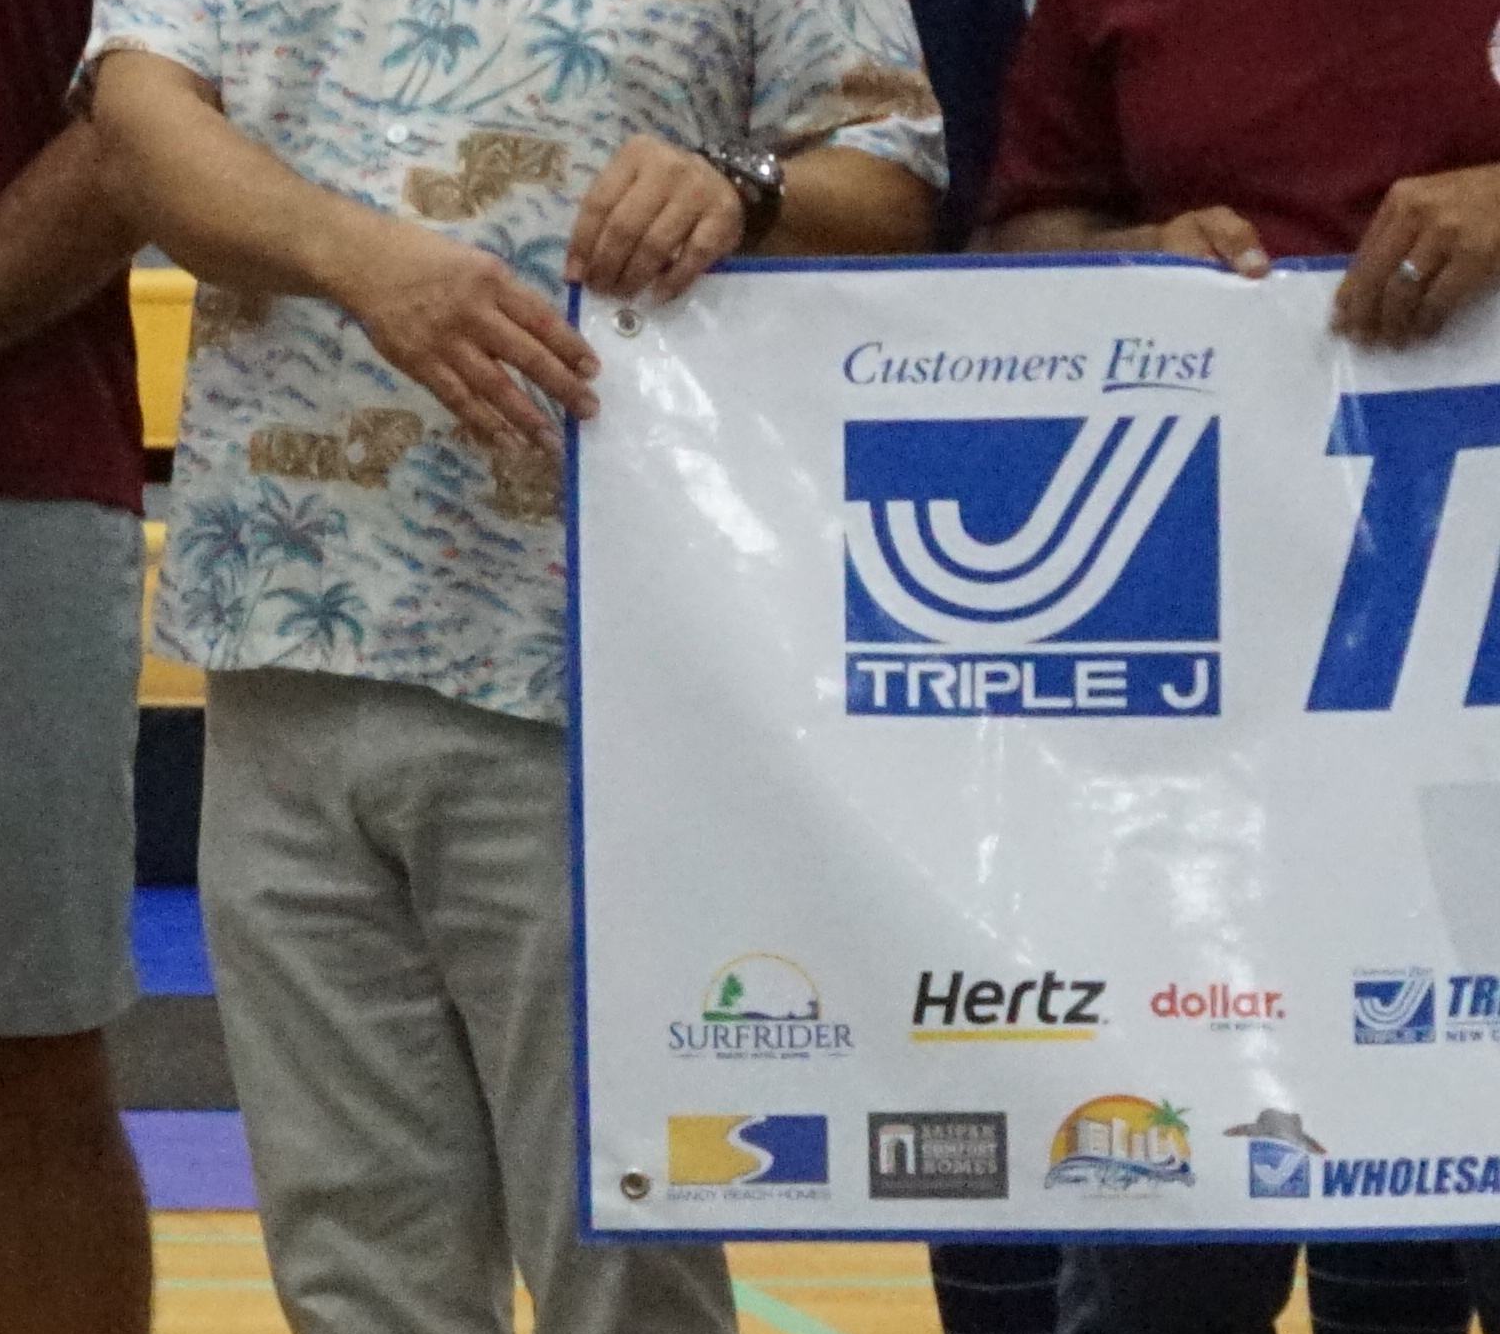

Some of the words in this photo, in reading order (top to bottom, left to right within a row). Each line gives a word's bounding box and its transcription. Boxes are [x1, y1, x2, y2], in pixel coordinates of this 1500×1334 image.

[842, 340, 1088, 385] Customers
[1104, 337, 1216, 381] First
[856, 659, 1128, 710] TRIPLE
[1160, 658, 1210, 710] J
[912, 970, 1107, 1025] Hertz
[1447, 974, 1500, 1018] TR
[668, 1021, 855, 1050] SURFRIDER
